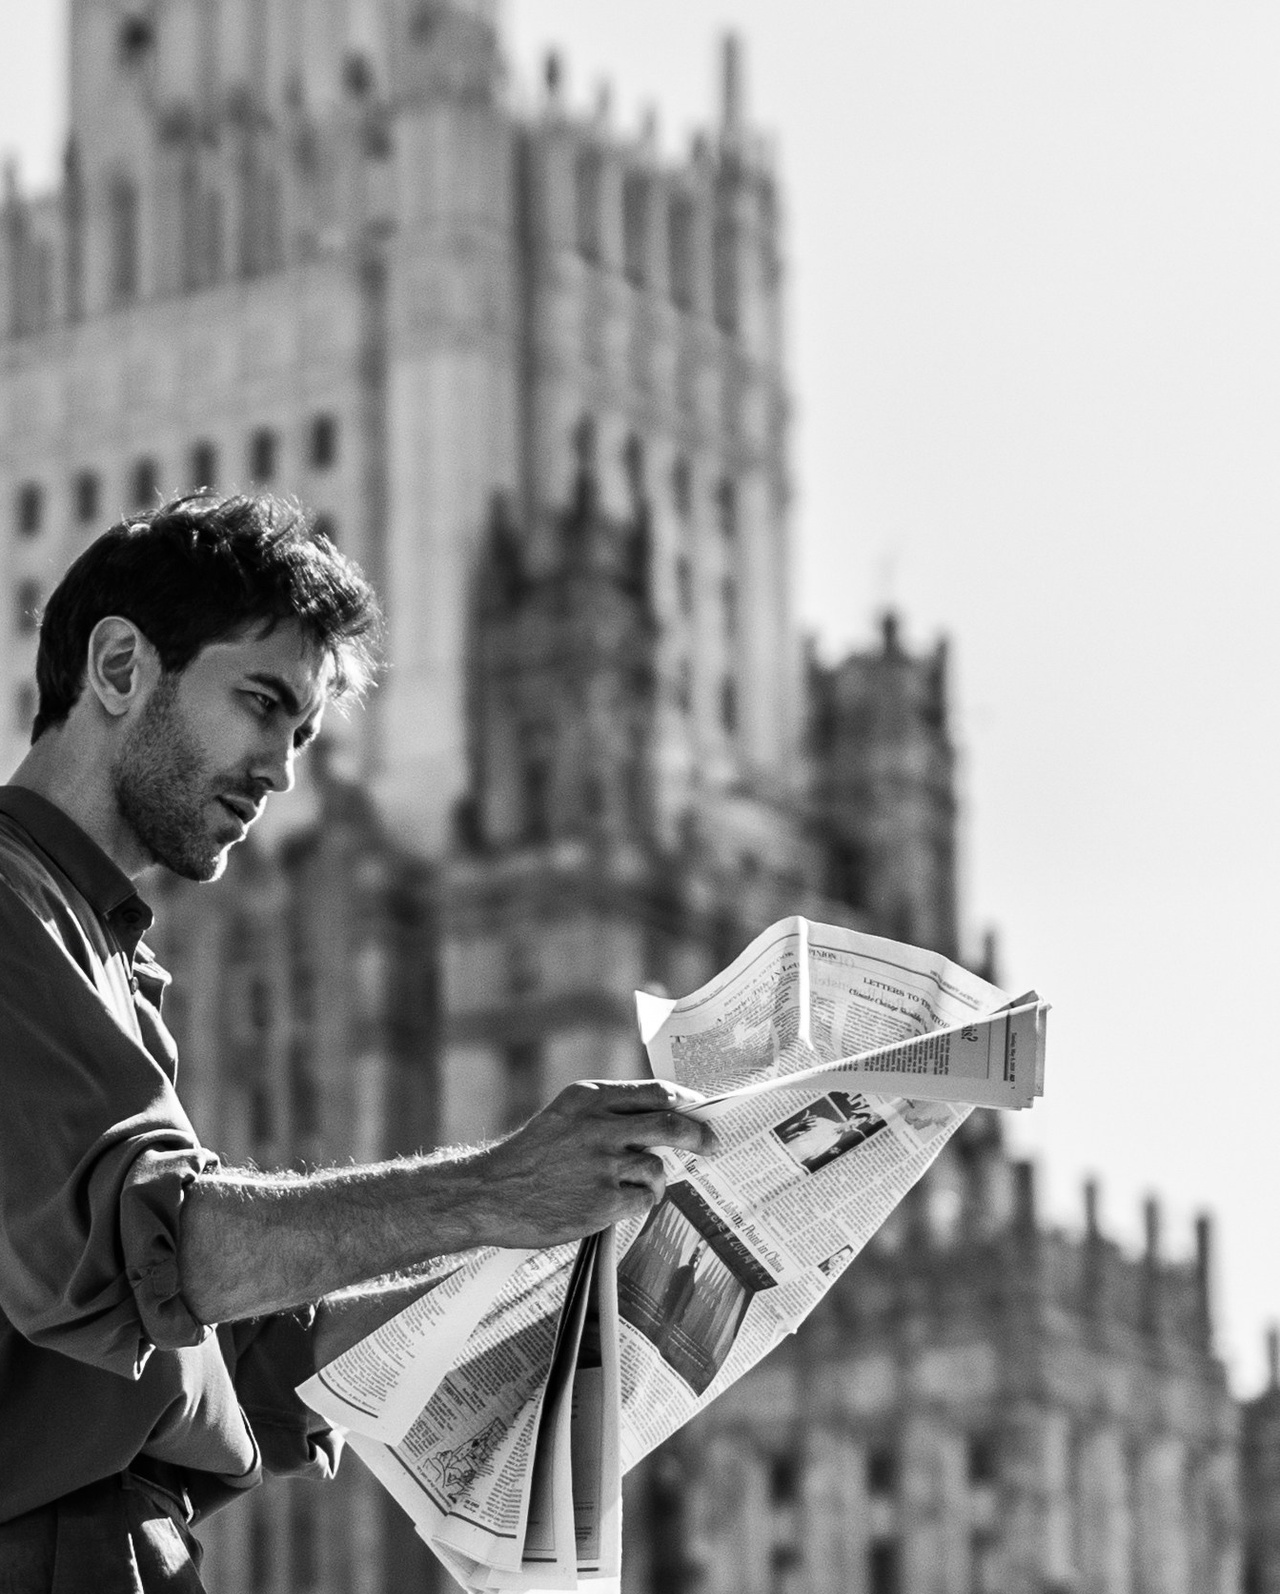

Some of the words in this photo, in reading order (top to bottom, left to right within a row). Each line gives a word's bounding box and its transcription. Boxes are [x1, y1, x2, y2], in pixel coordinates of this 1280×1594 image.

[807, 948, 837, 960] PINION
[863, 977, 905, 997] LETTERS
[907, 993, 920, 1002] TO
[741, 1222, 763, 1247] Point
[757, 1242, 770, 1255] in
[764, 1249, 786, 1274] China
